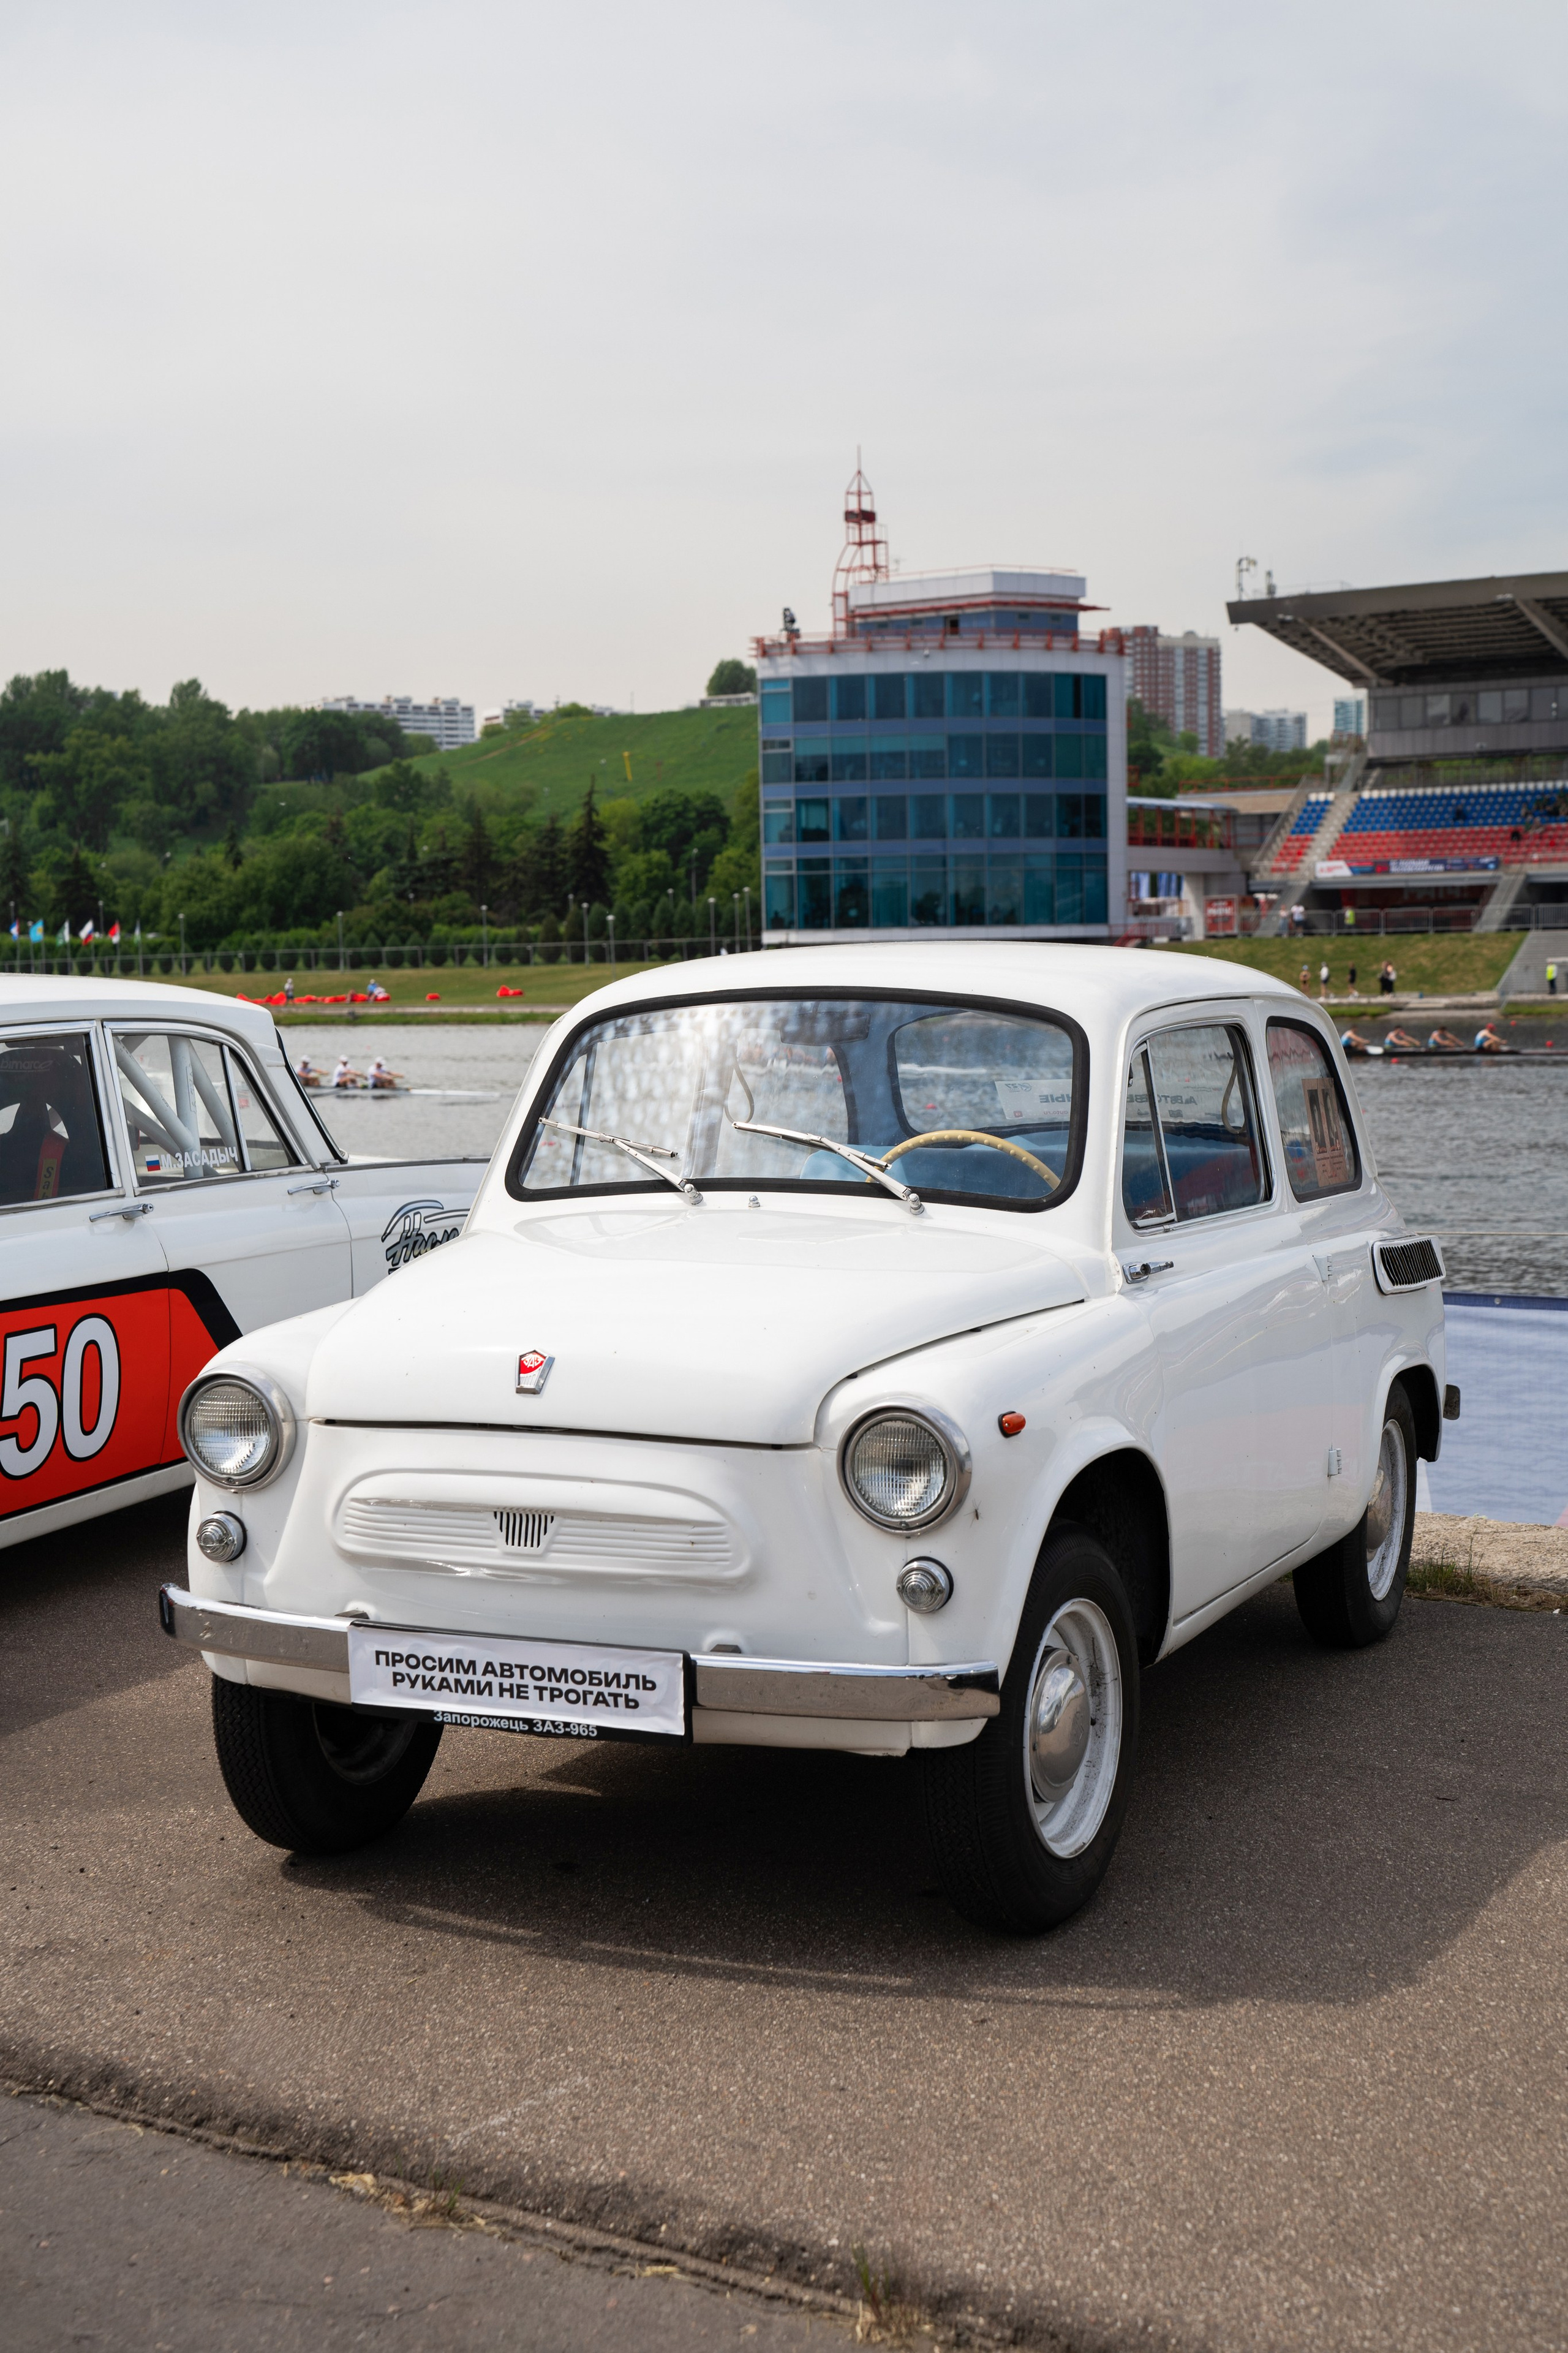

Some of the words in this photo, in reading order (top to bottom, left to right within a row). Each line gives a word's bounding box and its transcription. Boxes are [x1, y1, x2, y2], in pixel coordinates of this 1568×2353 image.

[160, 1146, 239, 1169] М.ЗАСАДЫЧ
[521, 1353, 545, 1369] ЗАЗ
[0, 1313, 121, 1480] 50
[375, 1650, 477, 1675] ПРОСИМ
[481, 1661, 657, 1691] АВТОМОБИЛЬ
[392, 1671, 493, 1696] РУКАМИ
[498, 1682, 529, 1700] НЕ
[533, 1685, 639, 1709] ТРОГАТЬ
[433, 1709, 529, 1732] Запорожець
[532, 1719, 598, 1737] ЗАЗ-965
